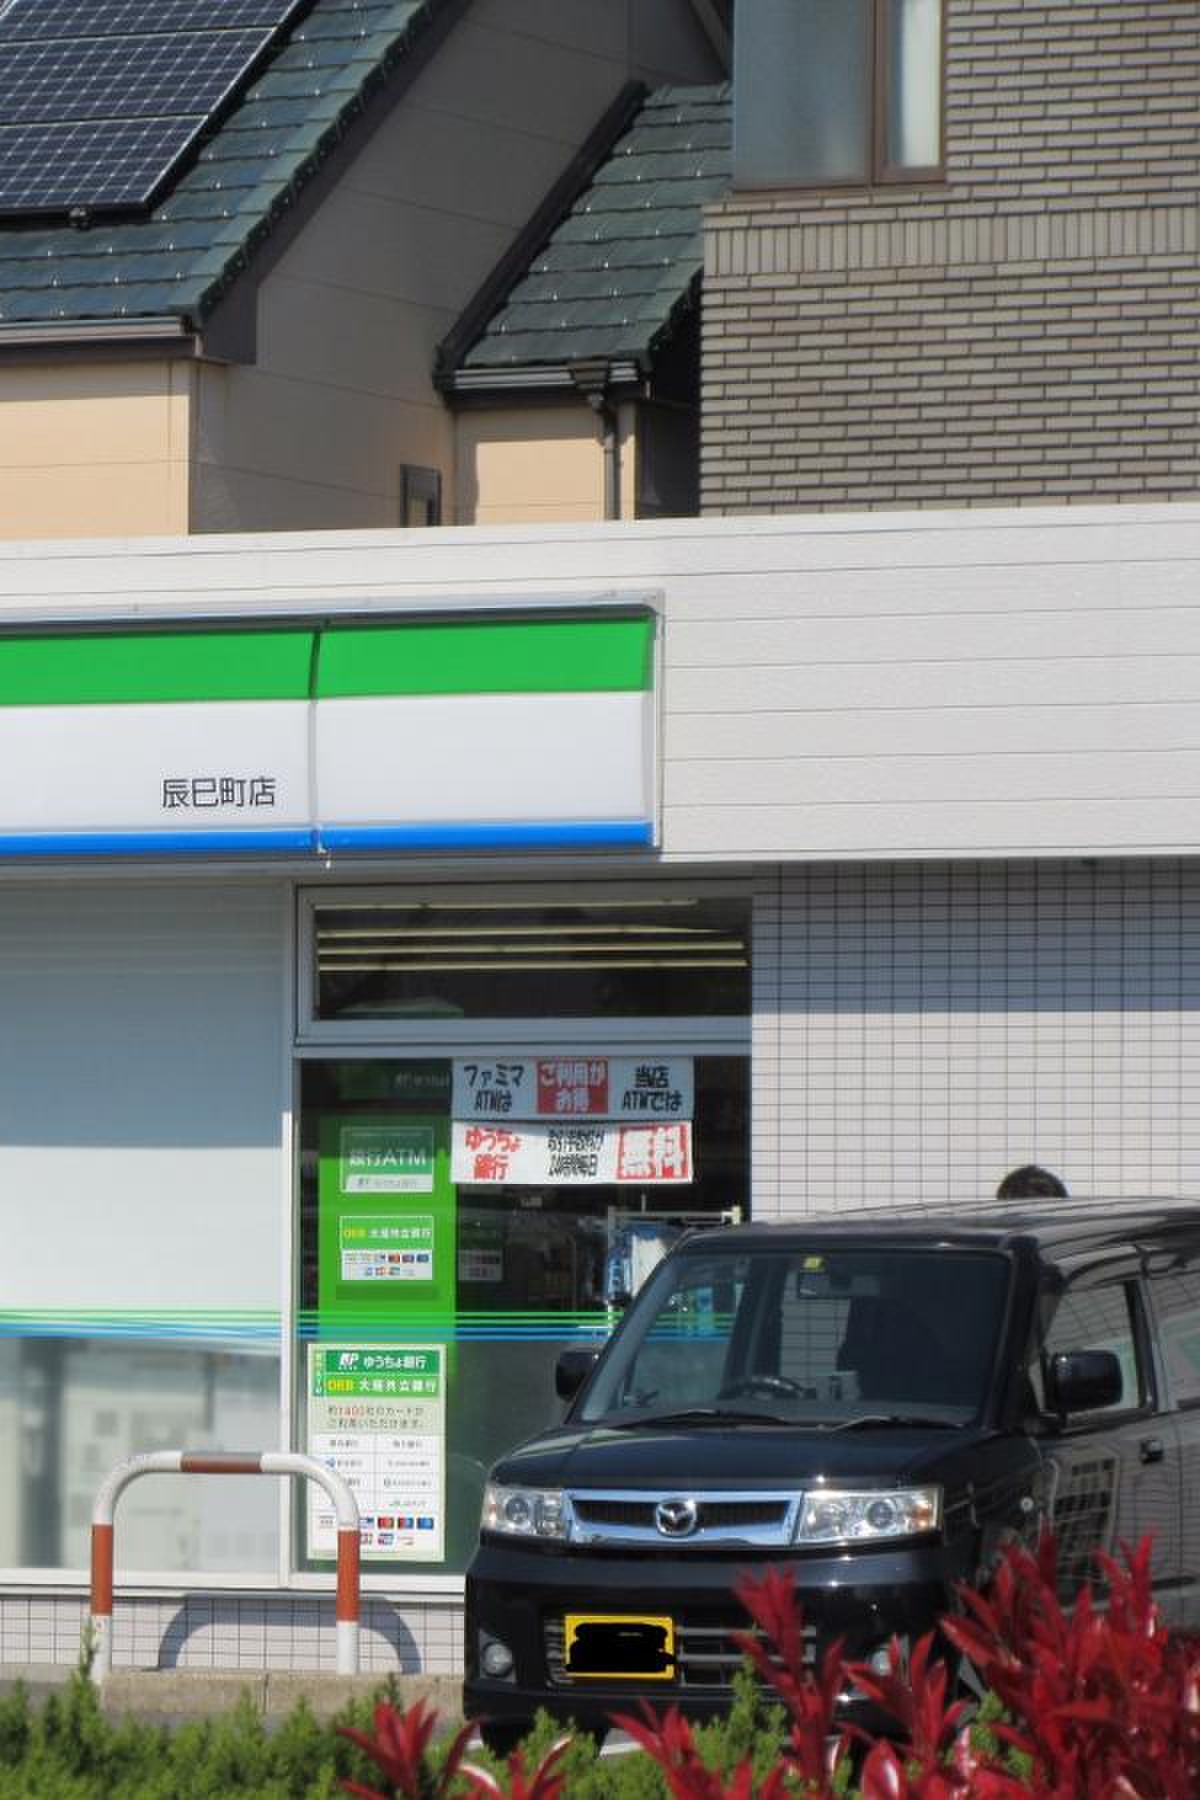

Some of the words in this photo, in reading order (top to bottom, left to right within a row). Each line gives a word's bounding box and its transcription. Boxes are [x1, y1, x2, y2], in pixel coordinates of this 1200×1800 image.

[162, 777, 276, 808] 辰巳町店
[463, 1064, 525, 1088] ファミマ
[634, 1064, 670, 1088] 当店
[474, 1090, 513, 1113] ATMは
[622, 1090, 683, 1112] ATMでは
[464, 1126, 522, 1153] ゆうちょ
[474, 1153, 509, 1180] 銀行
[363, 1355, 427, 1370] ゆうちょ銀行
